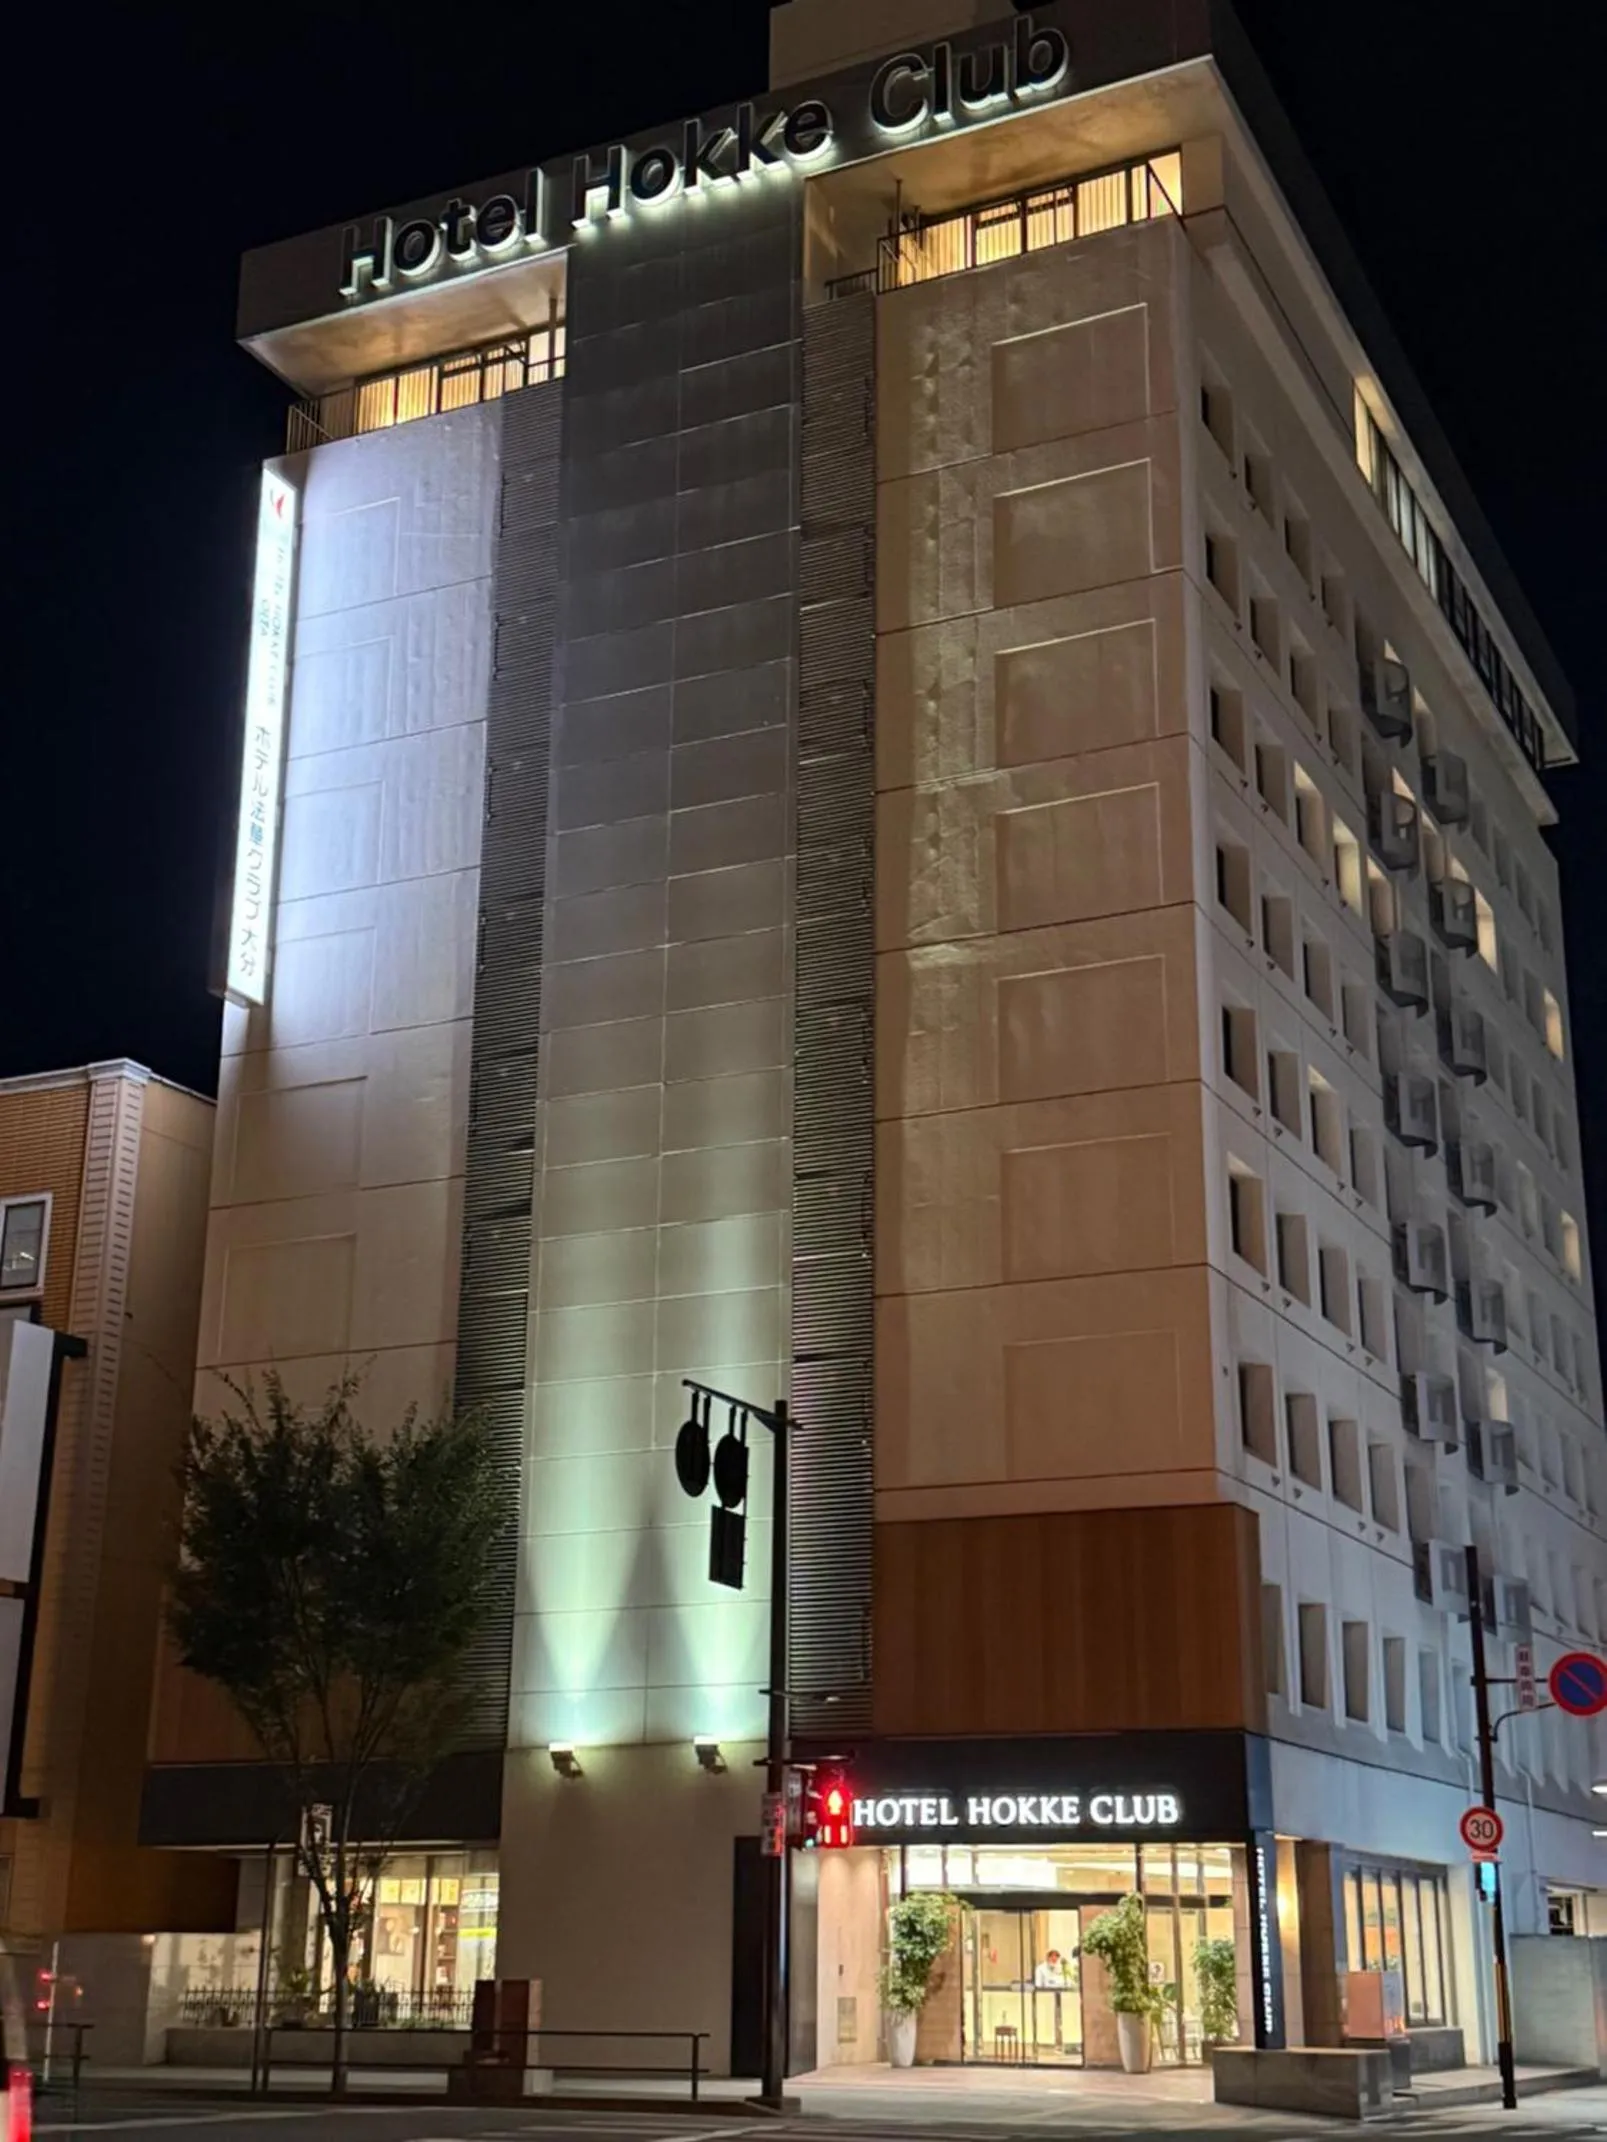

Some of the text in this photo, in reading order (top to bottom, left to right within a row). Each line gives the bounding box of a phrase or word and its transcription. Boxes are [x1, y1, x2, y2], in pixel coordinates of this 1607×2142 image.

[340, 14, 1069, 296] Hotel Hokke Club
[852, 1794, 1179, 1827] HOTEL HOKKE CLUB
[1470, 1819, 1495, 1840] 30
